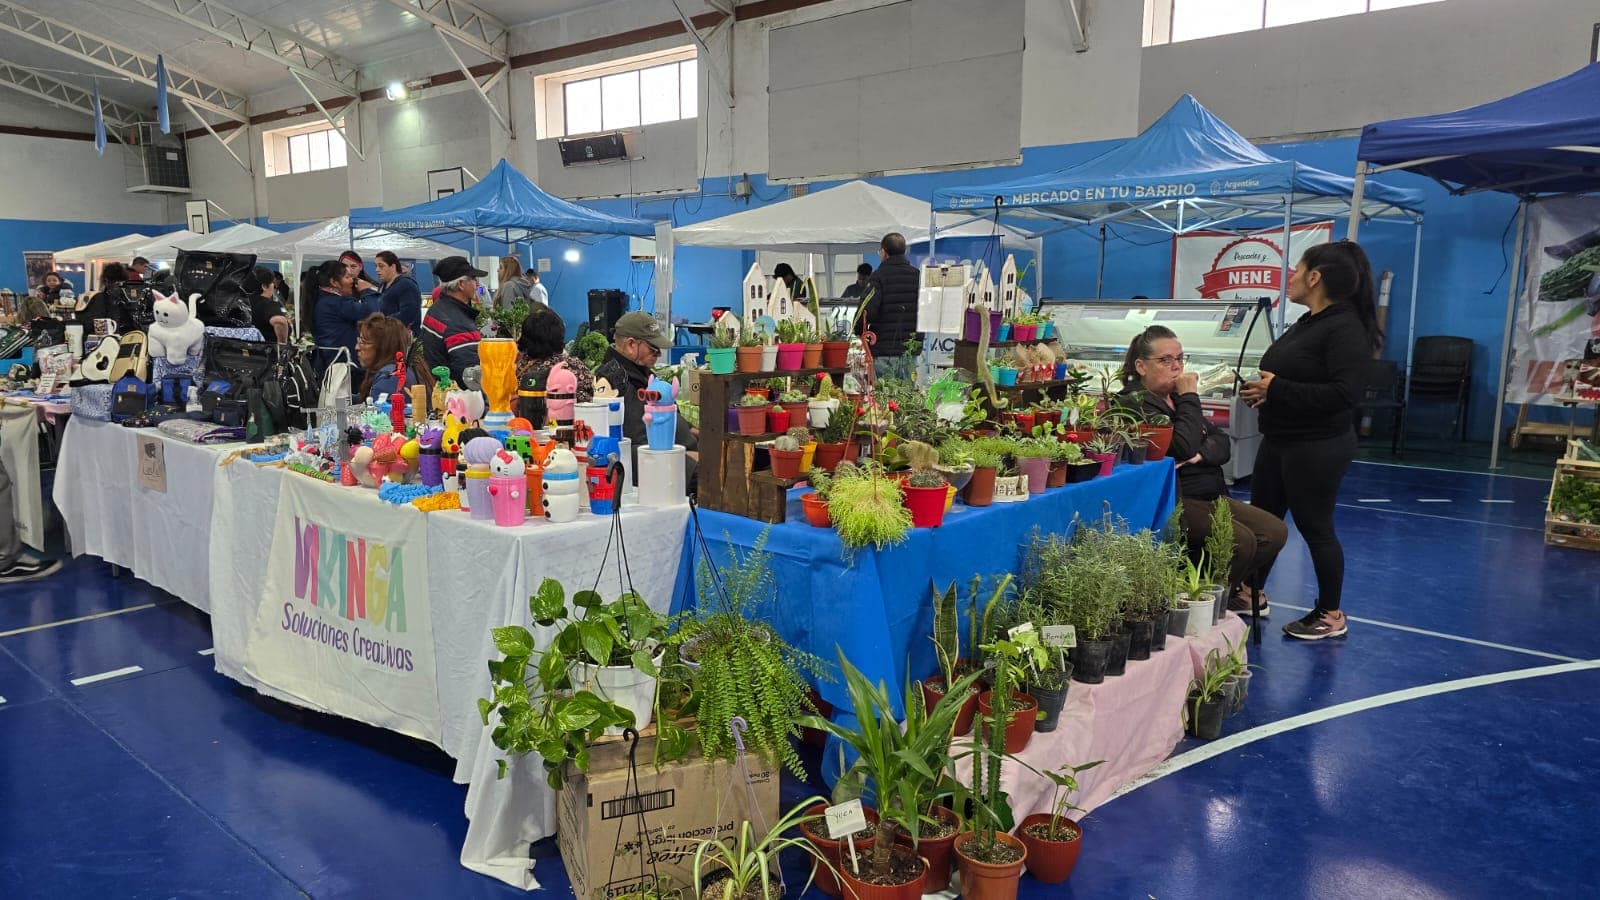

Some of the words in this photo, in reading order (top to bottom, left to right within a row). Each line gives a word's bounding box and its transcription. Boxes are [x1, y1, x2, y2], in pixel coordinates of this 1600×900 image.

[1012, 189, 1080, 205] MERCADO
[1085, 187, 1105, 200] EN
[1110, 186, 1129, 199] TU
[1135, 183, 1197, 198] BARRIO
[1224, 179, 1260, 190] Argentina
[1228, 270, 1272, 285] NENE
[294, 515, 407, 633] VIKINGA
[281, 602, 349, 653] Soluciones
[353, 627, 414, 672] Creativas
